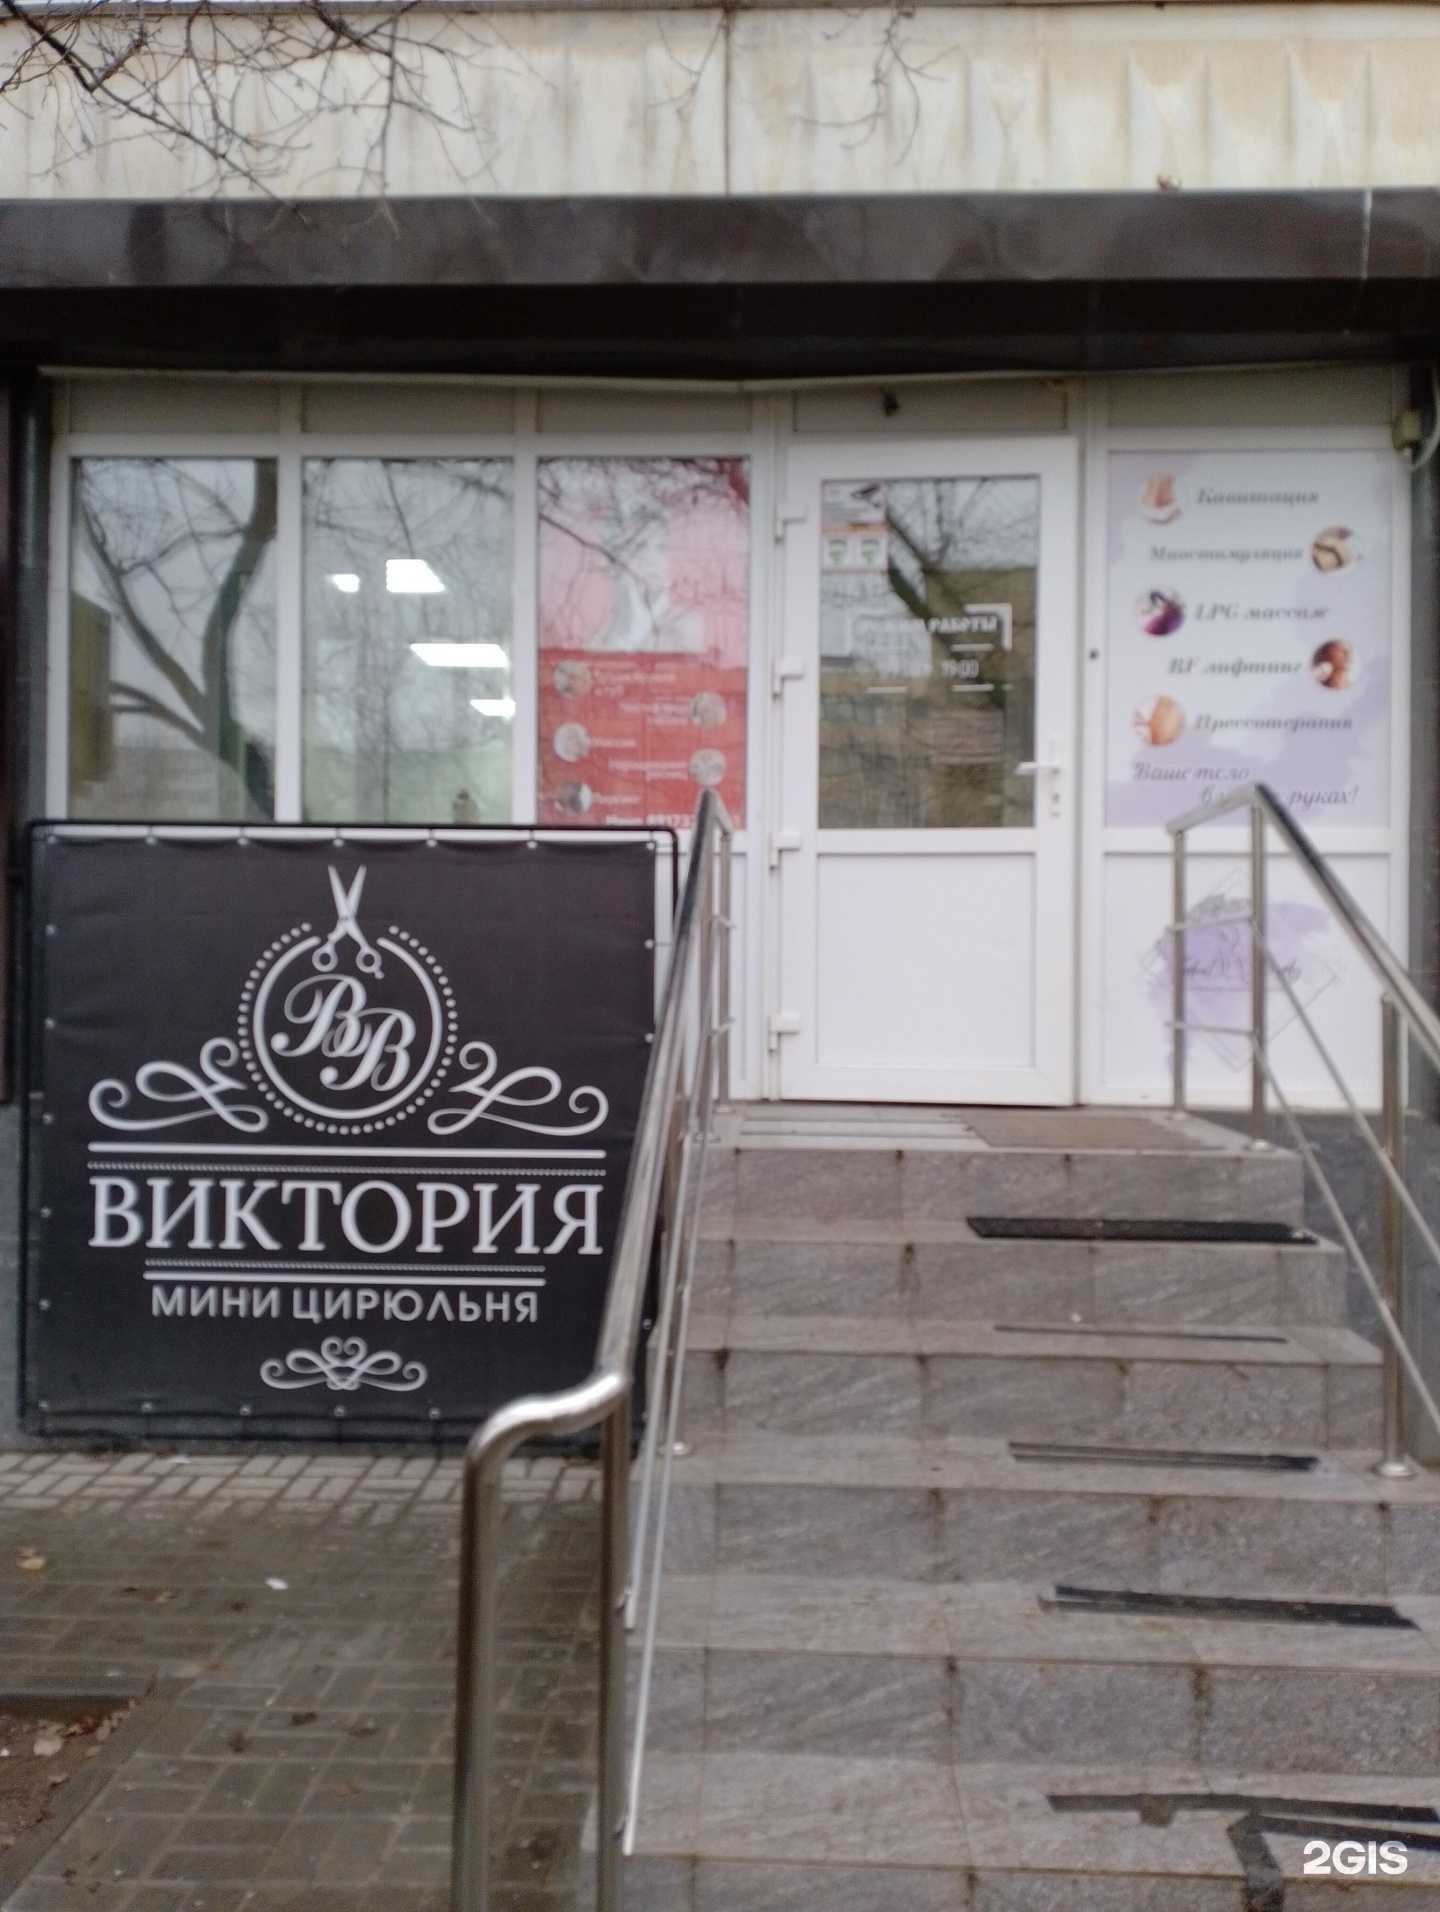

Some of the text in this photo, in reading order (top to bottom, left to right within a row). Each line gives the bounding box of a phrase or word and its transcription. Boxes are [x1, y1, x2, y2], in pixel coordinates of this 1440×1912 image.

[88, 1177, 604, 1256] ВИКТОРИЯ
[151, 1285, 538, 1324] МИНИ ЦИРЮЛЬНЯ
